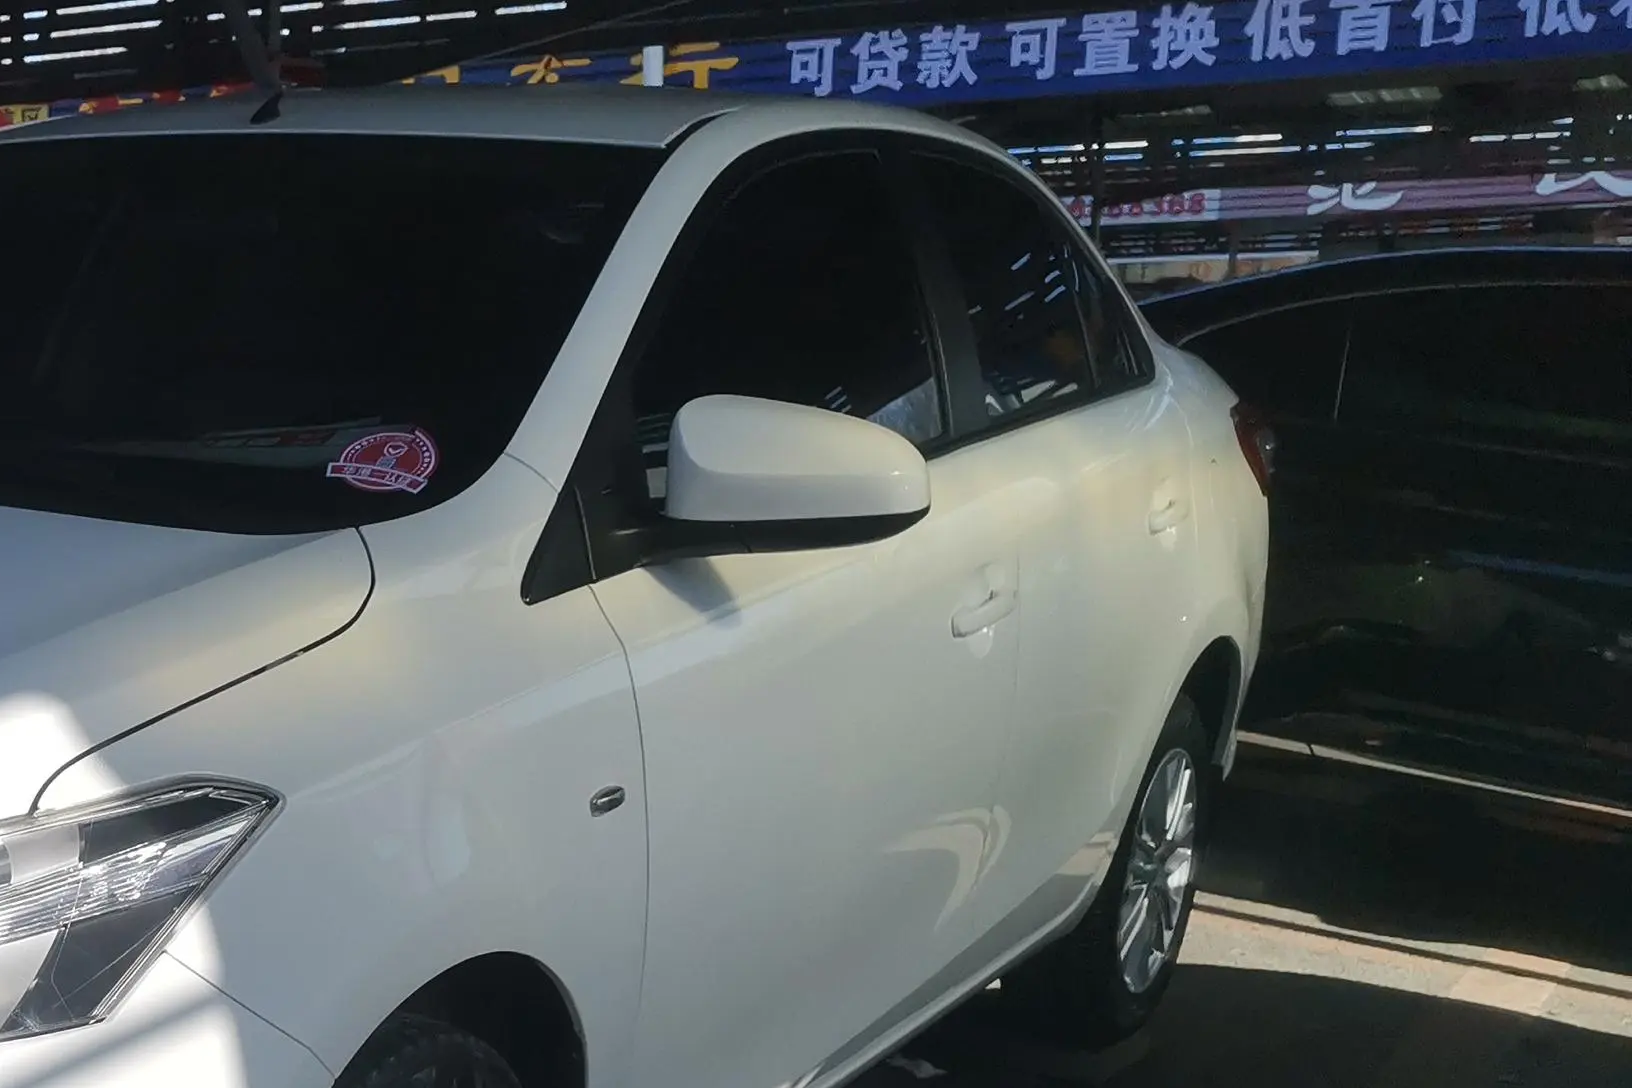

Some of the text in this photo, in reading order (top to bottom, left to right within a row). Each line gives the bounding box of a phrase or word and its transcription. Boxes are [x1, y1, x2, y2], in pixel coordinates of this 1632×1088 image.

[785, 24, 981, 98] 可贷款
[1005, 2, 1220, 80] 可置换
[1244, 0, 1477, 62] 低首付
